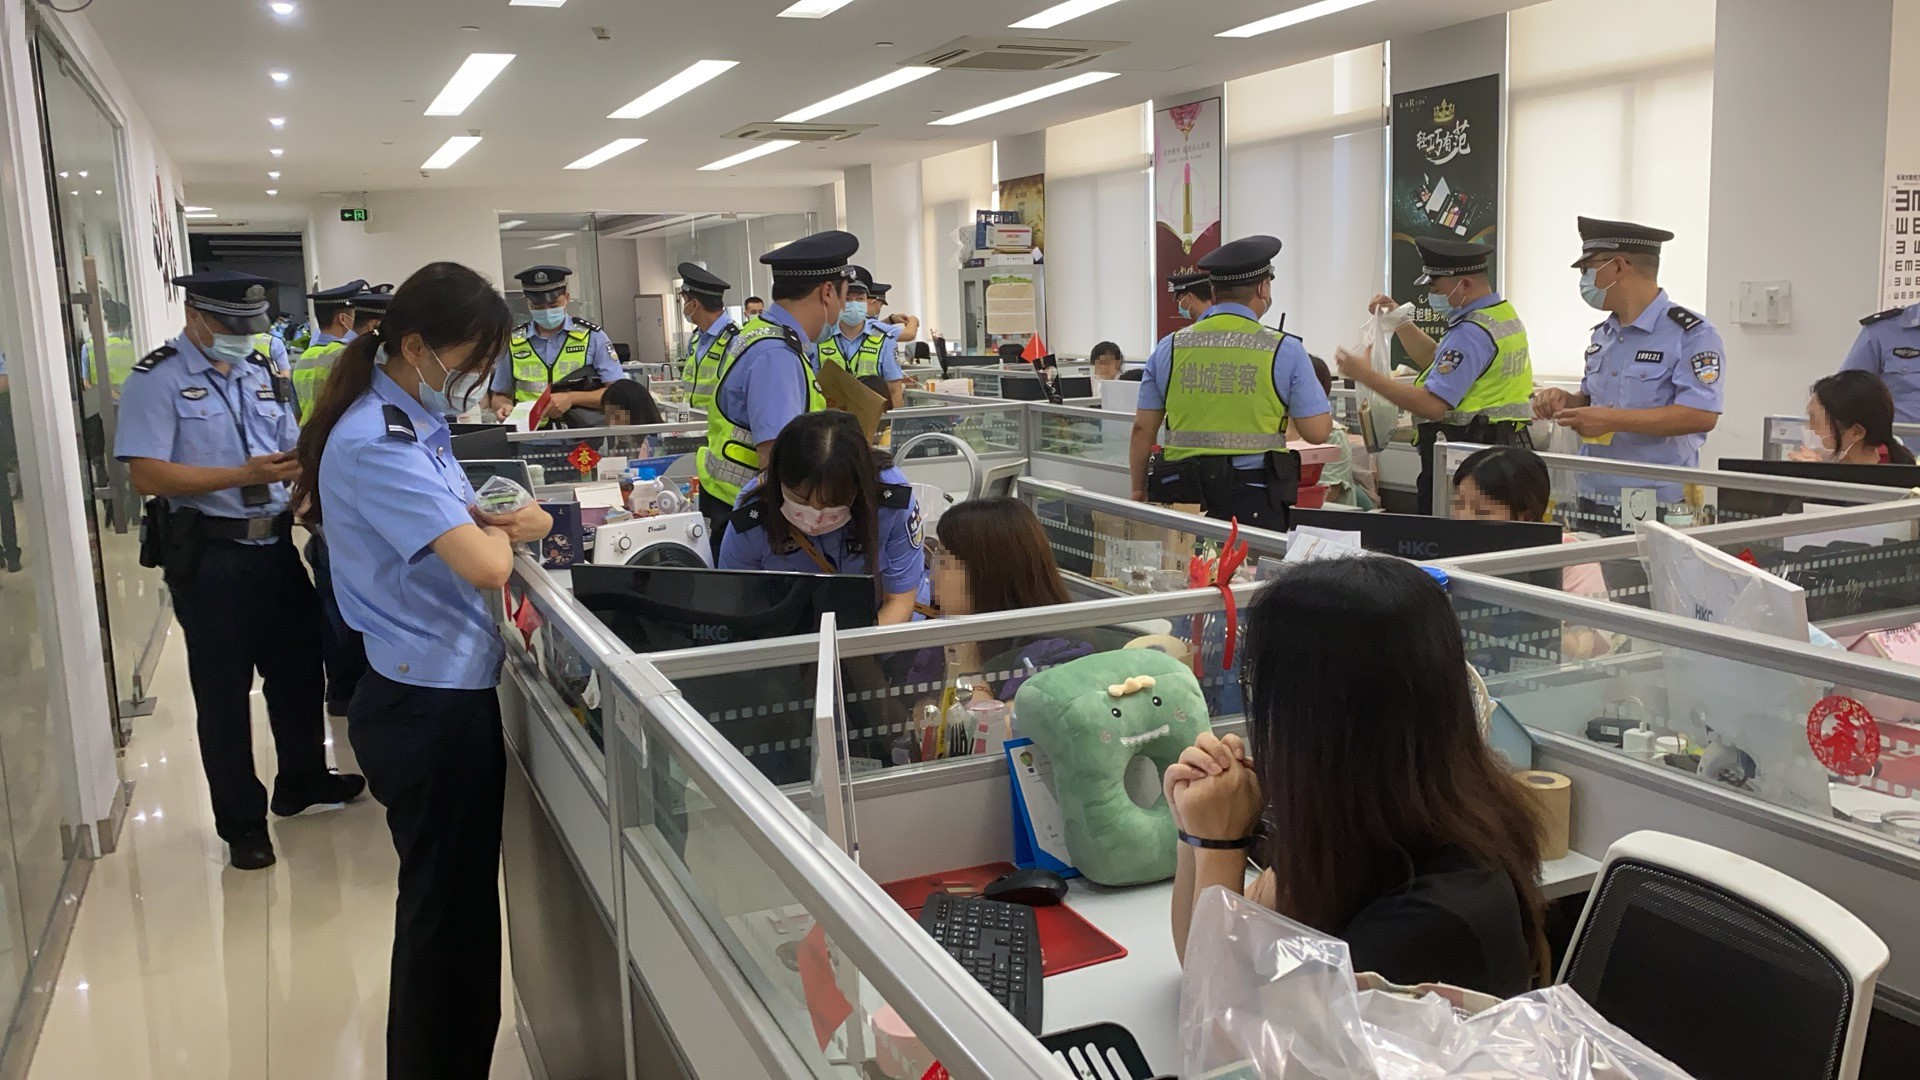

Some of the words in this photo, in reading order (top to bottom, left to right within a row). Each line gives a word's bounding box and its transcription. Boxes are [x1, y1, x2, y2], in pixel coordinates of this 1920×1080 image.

[1416, 119, 1471, 164] 轻巧有范
[1180, 362, 1258, 395] 禅城警察
[1398, 540, 1439, 557] HKC
[692, 623, 729, 642] HKC
